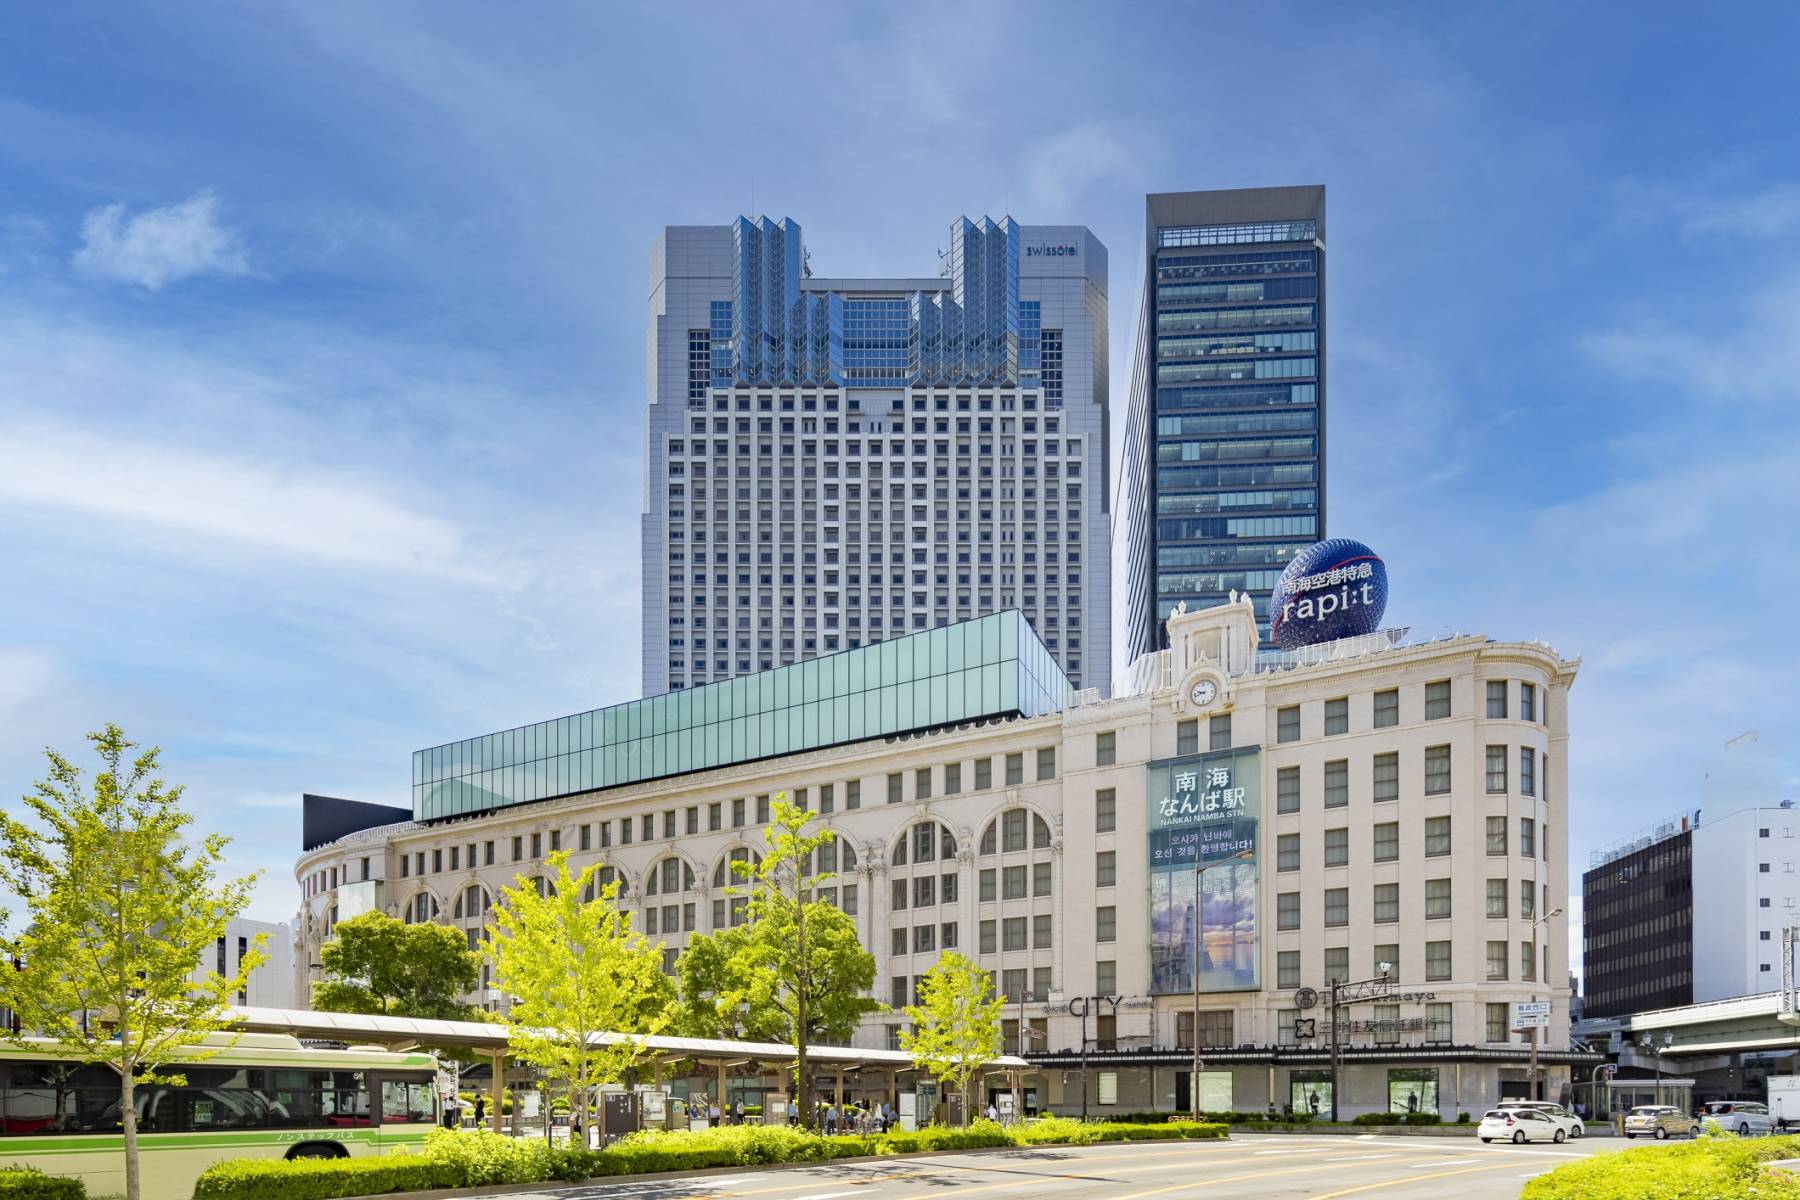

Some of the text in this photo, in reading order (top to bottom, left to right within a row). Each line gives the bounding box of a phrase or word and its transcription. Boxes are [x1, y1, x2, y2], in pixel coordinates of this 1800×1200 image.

[1282, 562, 1373, 594] 南海空港特急
[1159, 787, 1245, 816] なんば駅
[1160, 815, 1192, 826] NANKAI
[1193, 811, 1225, 822] NAMBA
[1203, 829, 1232, 842] 난바에
[1200, 839, 1253, 854] 환영합니다!
[1069, 995, 1123, 1017] CITY
[1319, 1017, 1437, 1034] 三住友信託銀行
